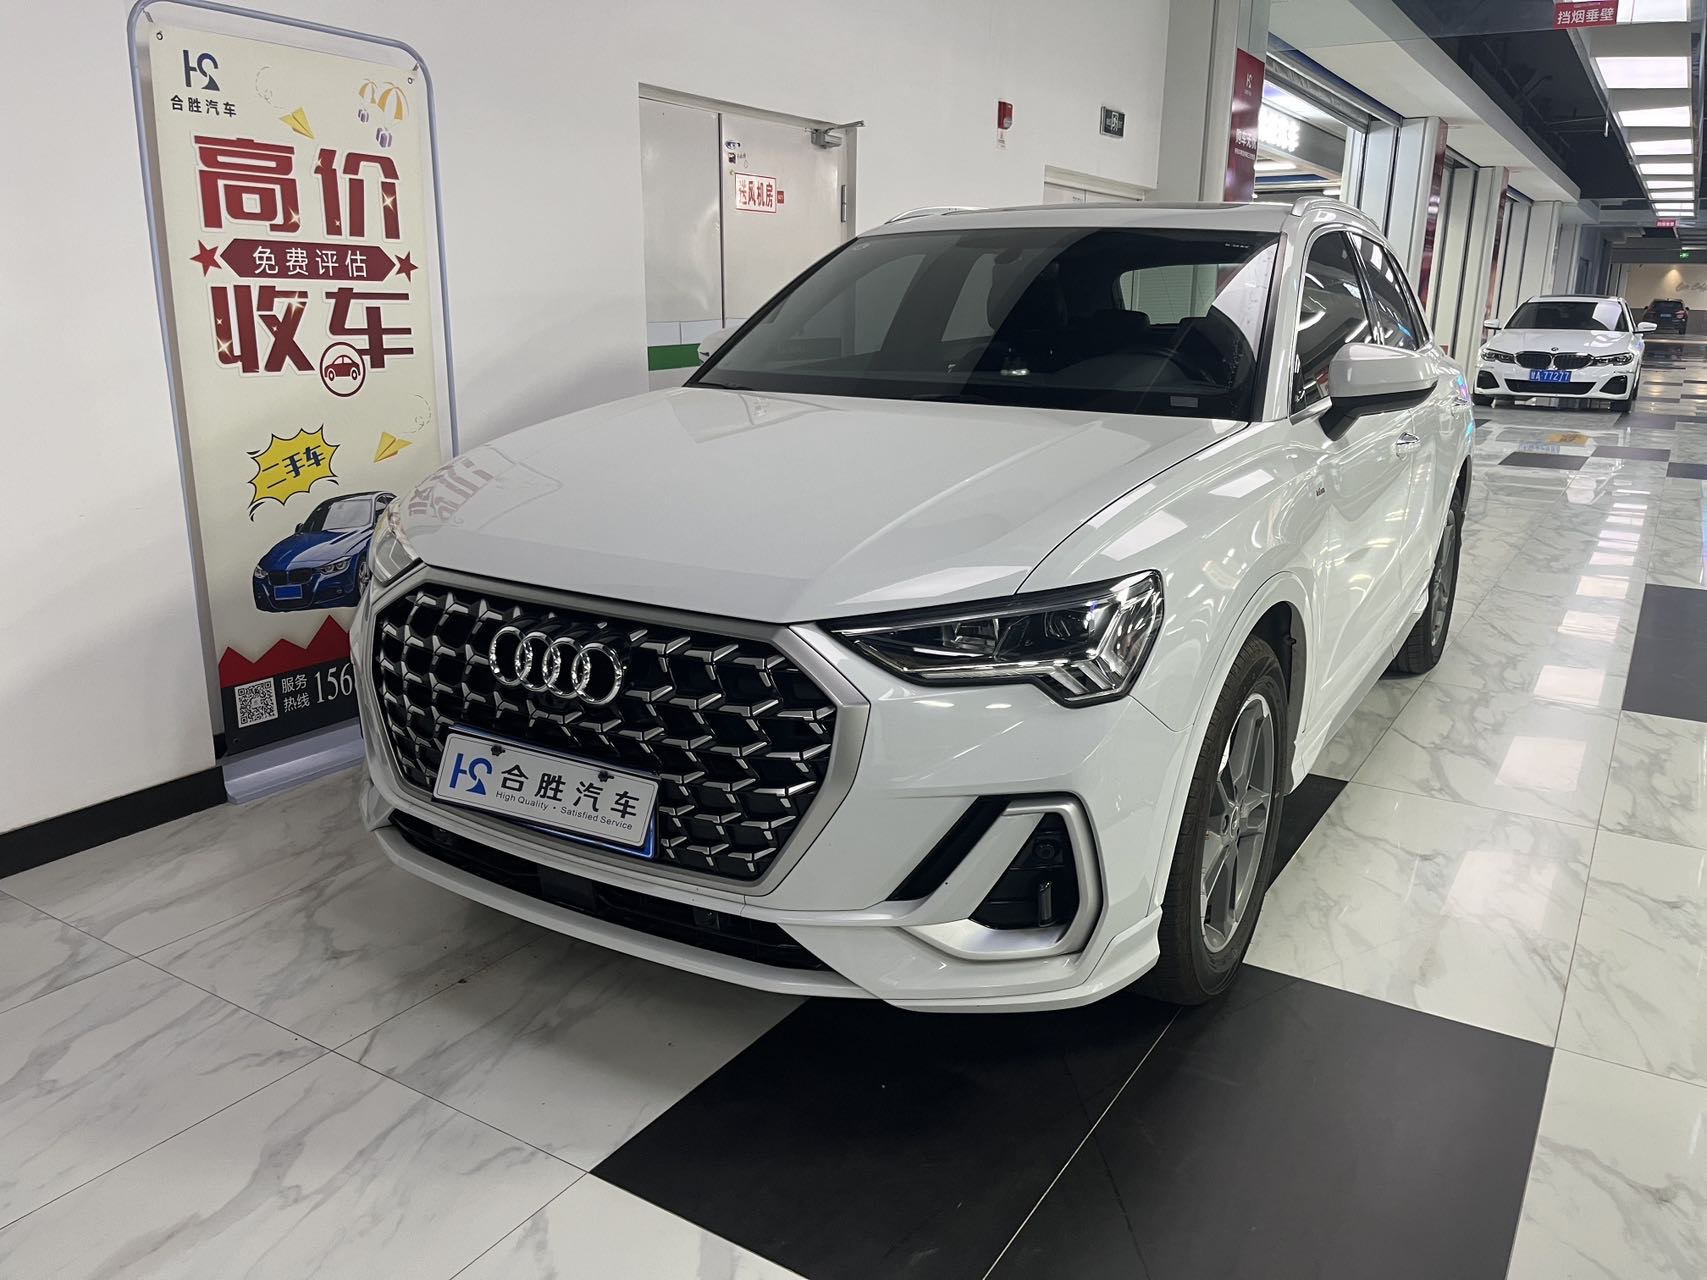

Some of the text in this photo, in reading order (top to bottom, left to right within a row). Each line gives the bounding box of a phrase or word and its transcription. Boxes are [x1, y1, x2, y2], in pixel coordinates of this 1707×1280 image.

[1557, 8, 1615, 25] 挡烟垂壁
[169, 94, 238, 119] 合胜汽车
[193, 134, 402, 241] 高价
[252, 245, 369, 278] 免费评估
[209, 284, 415, 374] 收车
[261, 445, 326, 489] 二手车
[281, 662, 353, 704] 服务 156
[283, 692, 310, 713] 热线
[495, 790, 633, 831] High Quality Satisfied Service
[500, 764, 640, 819] 合胜汽车
